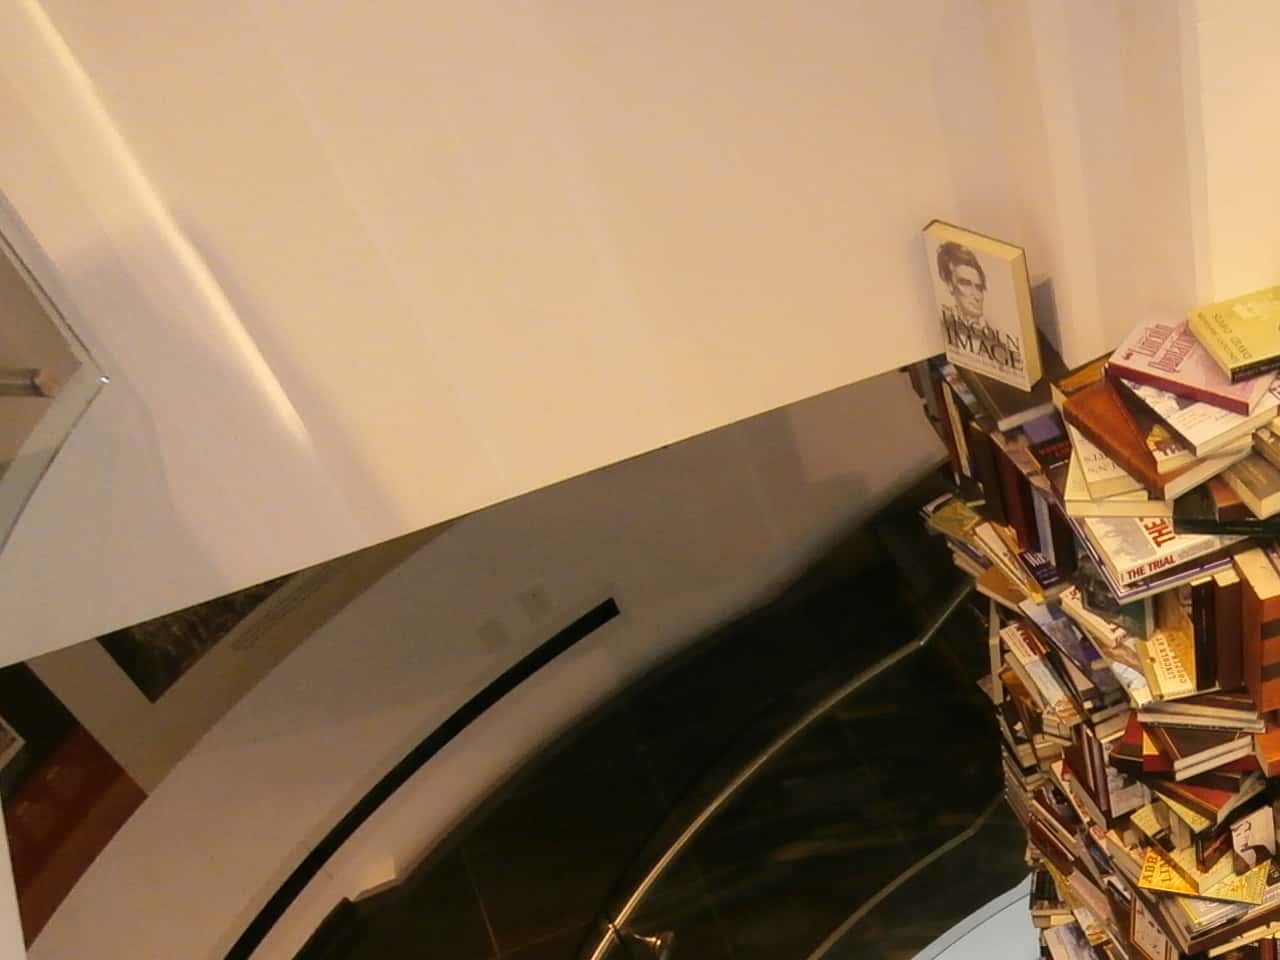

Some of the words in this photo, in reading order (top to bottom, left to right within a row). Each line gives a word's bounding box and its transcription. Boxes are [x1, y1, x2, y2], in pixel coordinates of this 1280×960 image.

[941, 308, 1021, 350] LINCOLN
[950, 332, 1023, 371] IMAGE
[1145, 519, 1176, 547] THE
[1127, 563, 1147, 580] THE
[1148, 555, 1176, 572] TRIAL
